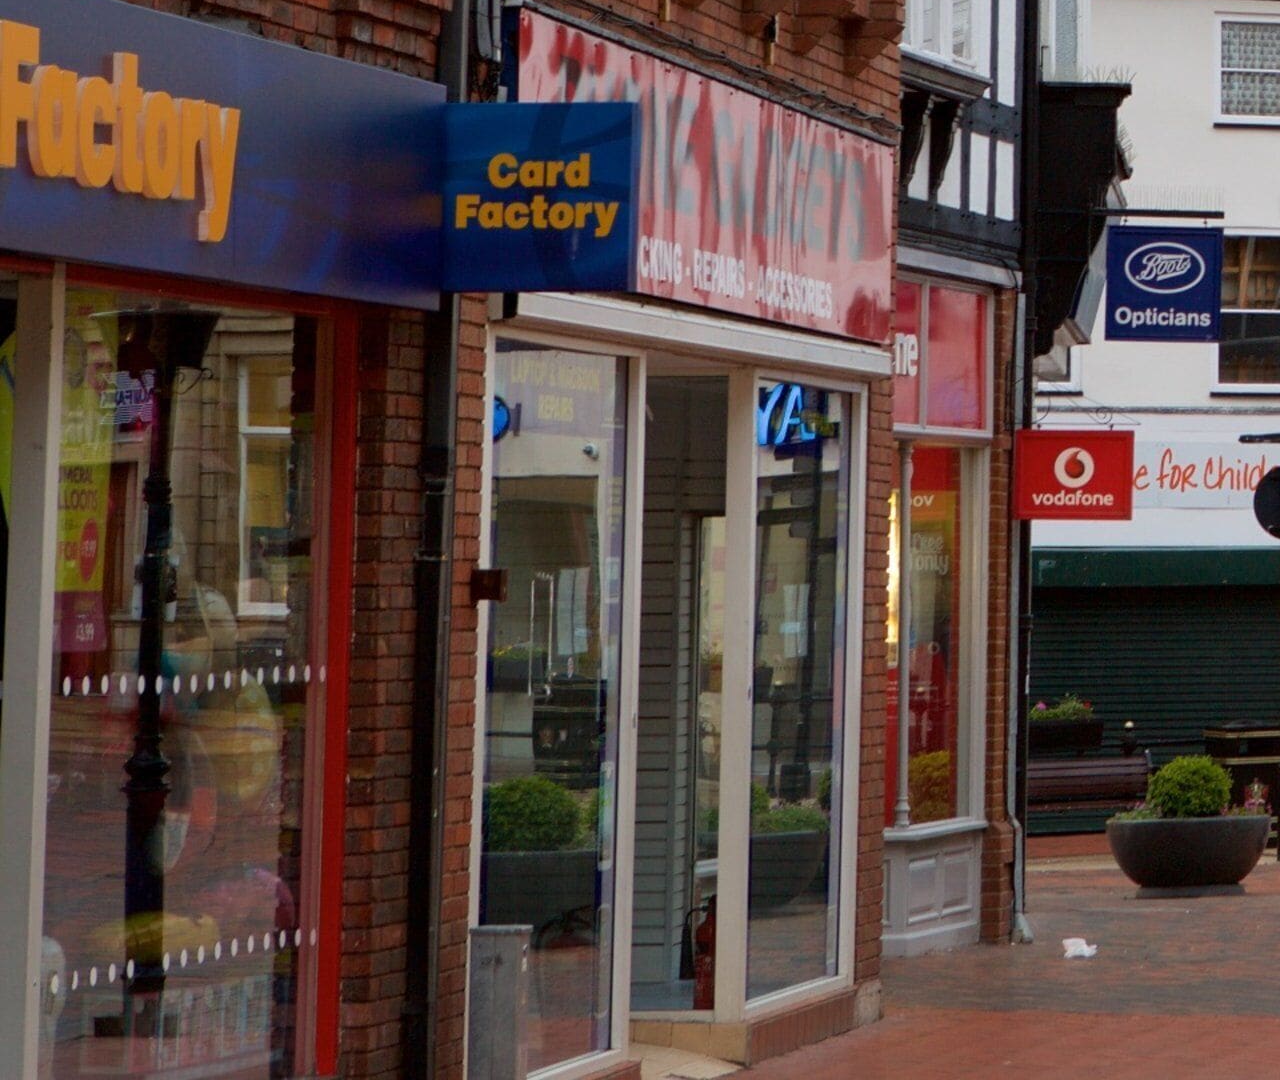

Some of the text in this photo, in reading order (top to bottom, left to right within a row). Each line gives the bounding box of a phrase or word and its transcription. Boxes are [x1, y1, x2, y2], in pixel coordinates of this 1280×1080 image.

[0, 19, 241, 243] Factory
[487, 152, 591, 189] Card
[454, 194, 620, 238] Factory
[637, 234, 833, 319] CKING REPAIRS ACCESSORIES
[1135, 251, 1192, 282] Boots
[1114, 305, 1212, 329] Opticians
[893, 332, 919, 377] ne
[1132, 463, 1150, 491] e
[1203, 453, 1278, 492] Child
[1032, 488, 1114, 508] vodafone
